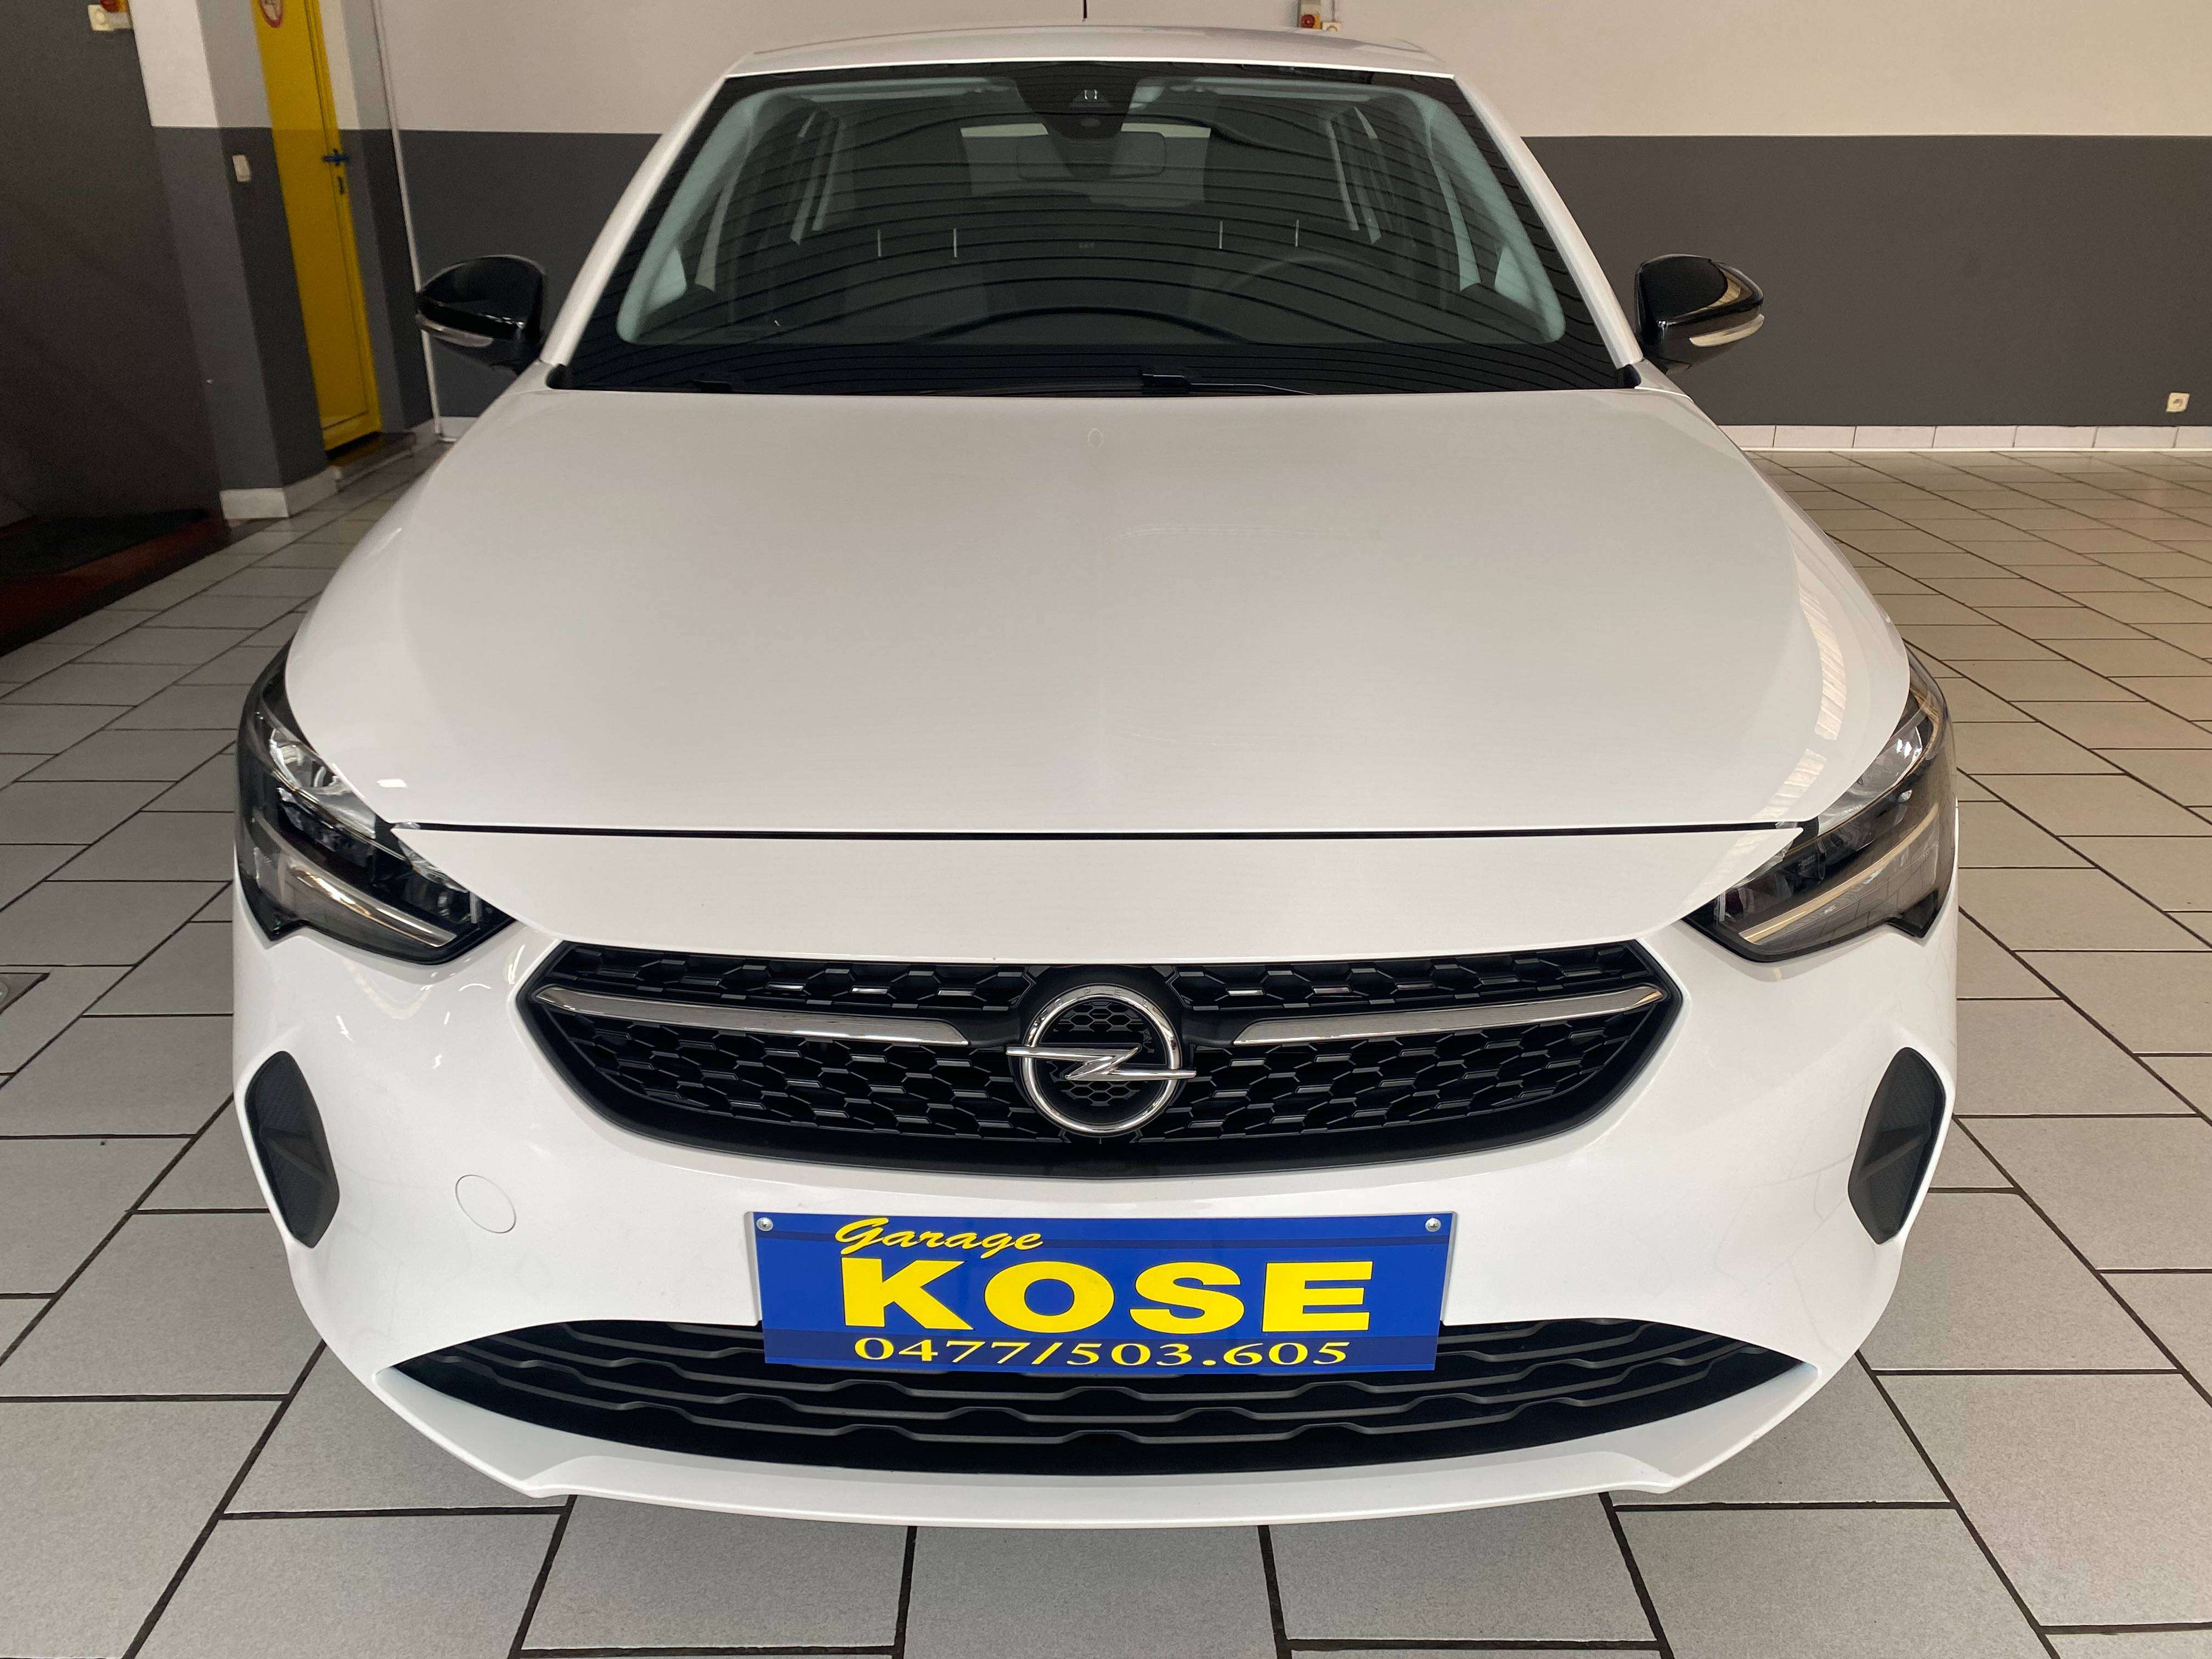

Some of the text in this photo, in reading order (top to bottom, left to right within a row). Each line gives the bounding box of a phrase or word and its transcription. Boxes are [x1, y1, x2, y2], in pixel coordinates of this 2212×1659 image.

[835, 1217, 1042, 1259] Garage
[840, 1256, 1374, 1335] KOSE
[854, 1337, 1350, 1366] 0477/503.605
